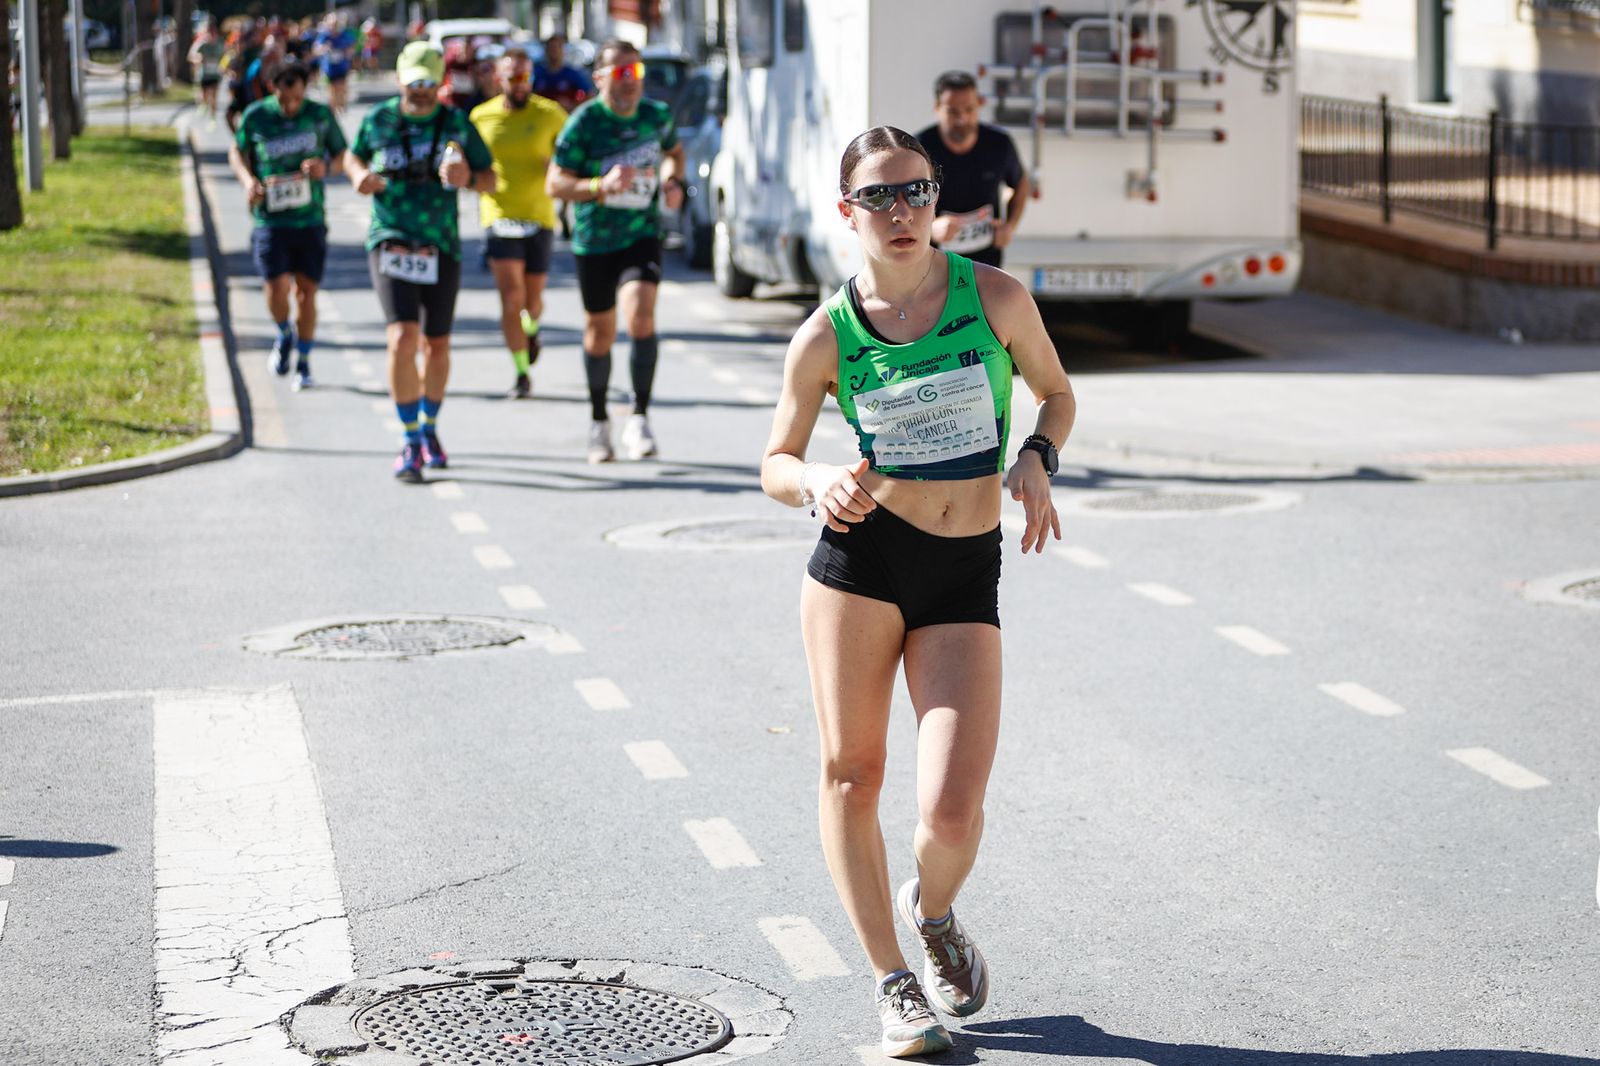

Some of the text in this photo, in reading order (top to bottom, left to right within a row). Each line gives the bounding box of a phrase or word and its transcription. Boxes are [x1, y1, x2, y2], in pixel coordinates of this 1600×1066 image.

[901, 352, 952, 372] Fundación
[901, 362, 940, 379] Unicaja
[881, 394, 913, 406] Diputación
[941, 389, 960, 398] contra
[890, 399, 916, 410] Granada
[917, 419, 959, 441] CÁNCER
